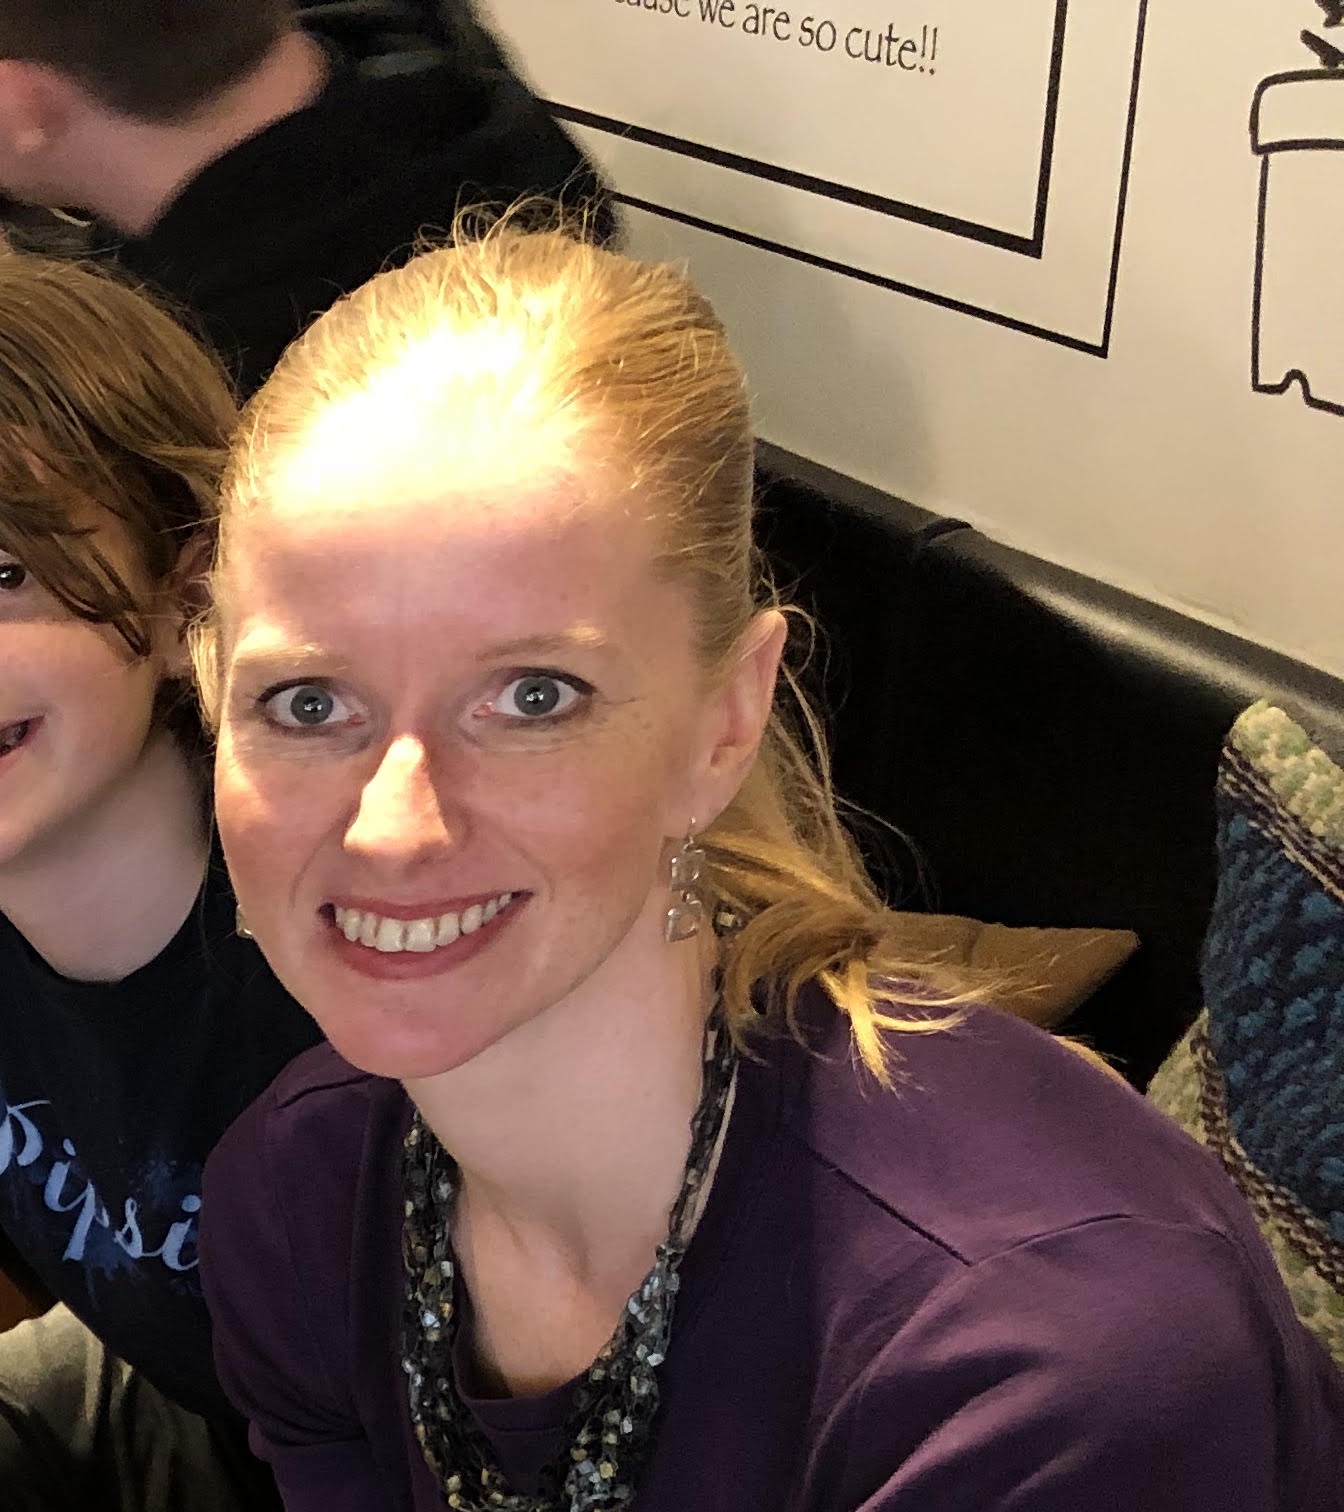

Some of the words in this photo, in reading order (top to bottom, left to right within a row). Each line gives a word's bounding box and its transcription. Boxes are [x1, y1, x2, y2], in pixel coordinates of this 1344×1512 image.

[698, 0, 735, 28] we
[742, 4, 791, 41] are
[798, 15, 837, 51] so
[845, 23, 939, 75] cute!!
